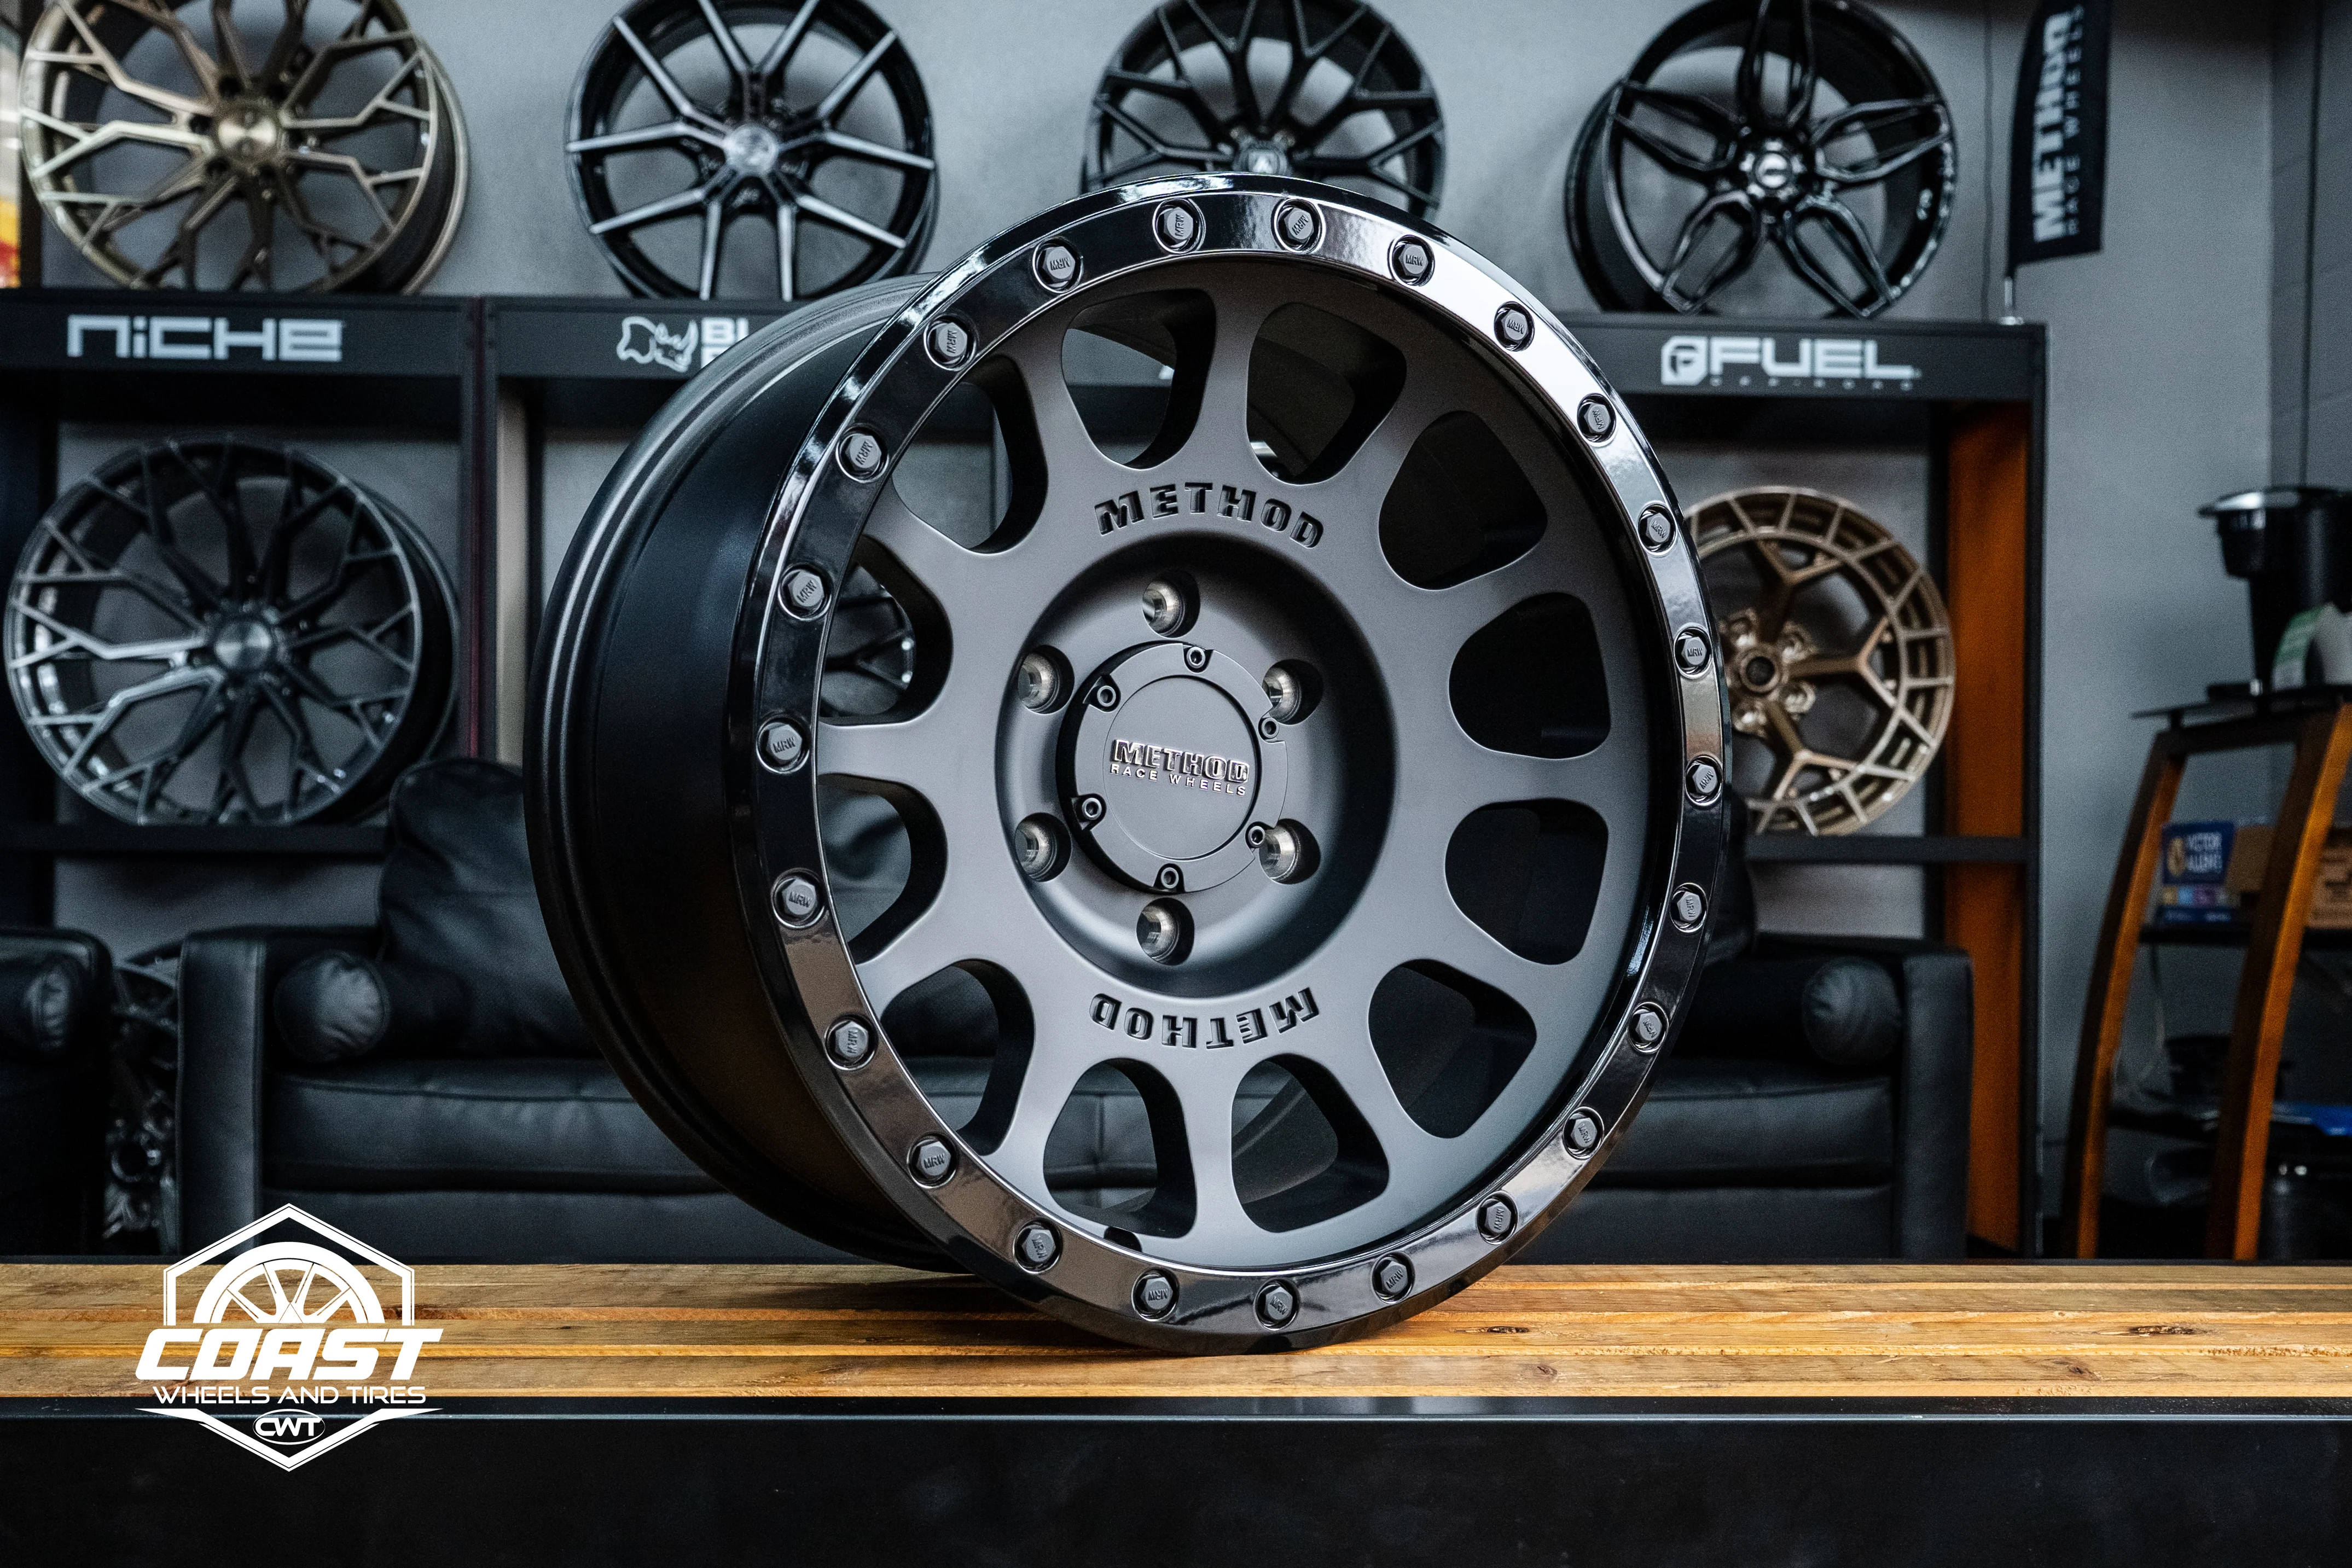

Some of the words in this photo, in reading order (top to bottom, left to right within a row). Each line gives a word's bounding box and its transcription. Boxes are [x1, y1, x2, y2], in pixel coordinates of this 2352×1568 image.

[2031, 11, 2072, 242] METHOD
[1175, 214, 1184, 236] MRW
[1291, 215, 1309, 235] MRW
[1050, 257, 1071, 271] MRW
[1406, 254, 1424, 266] MRW
[1506, 319, 1525, 334] MRW
[946, 330, 957, 353] MRW
[1710, 336, 1915, 379] FUEL
[1592, 409, 1605, 429] MRW
[855, 440, 873, 465] MRW
[1094, 482, 1324, 549] METHOD
[1651, 520, 1667, 538] MRW
[797, 579, 817, 603] MRW
[1687, 648, 1703, 657] MRW
[773, 736, 796, 753] MRW
[1111, 739, 1250, 783] METHOD
[1110, 764, 1158, 781] RACE
[1169, 773, 1246, 796] WHEELS
[788, 891, 812, 908] MRW
[1089, 987, 1320, 1050] METHOD
[1578, 1123, 1592, 1143] MRW
[924, 1152, 945, 1169] MRW
[1494, 1208, 1505, 1230] MRW
[1385, 1269, 1403, 1289] MRW
[1148, 1288, 1169, 1301] MRW
[1270, 1296, 1288, 1315] MRW
